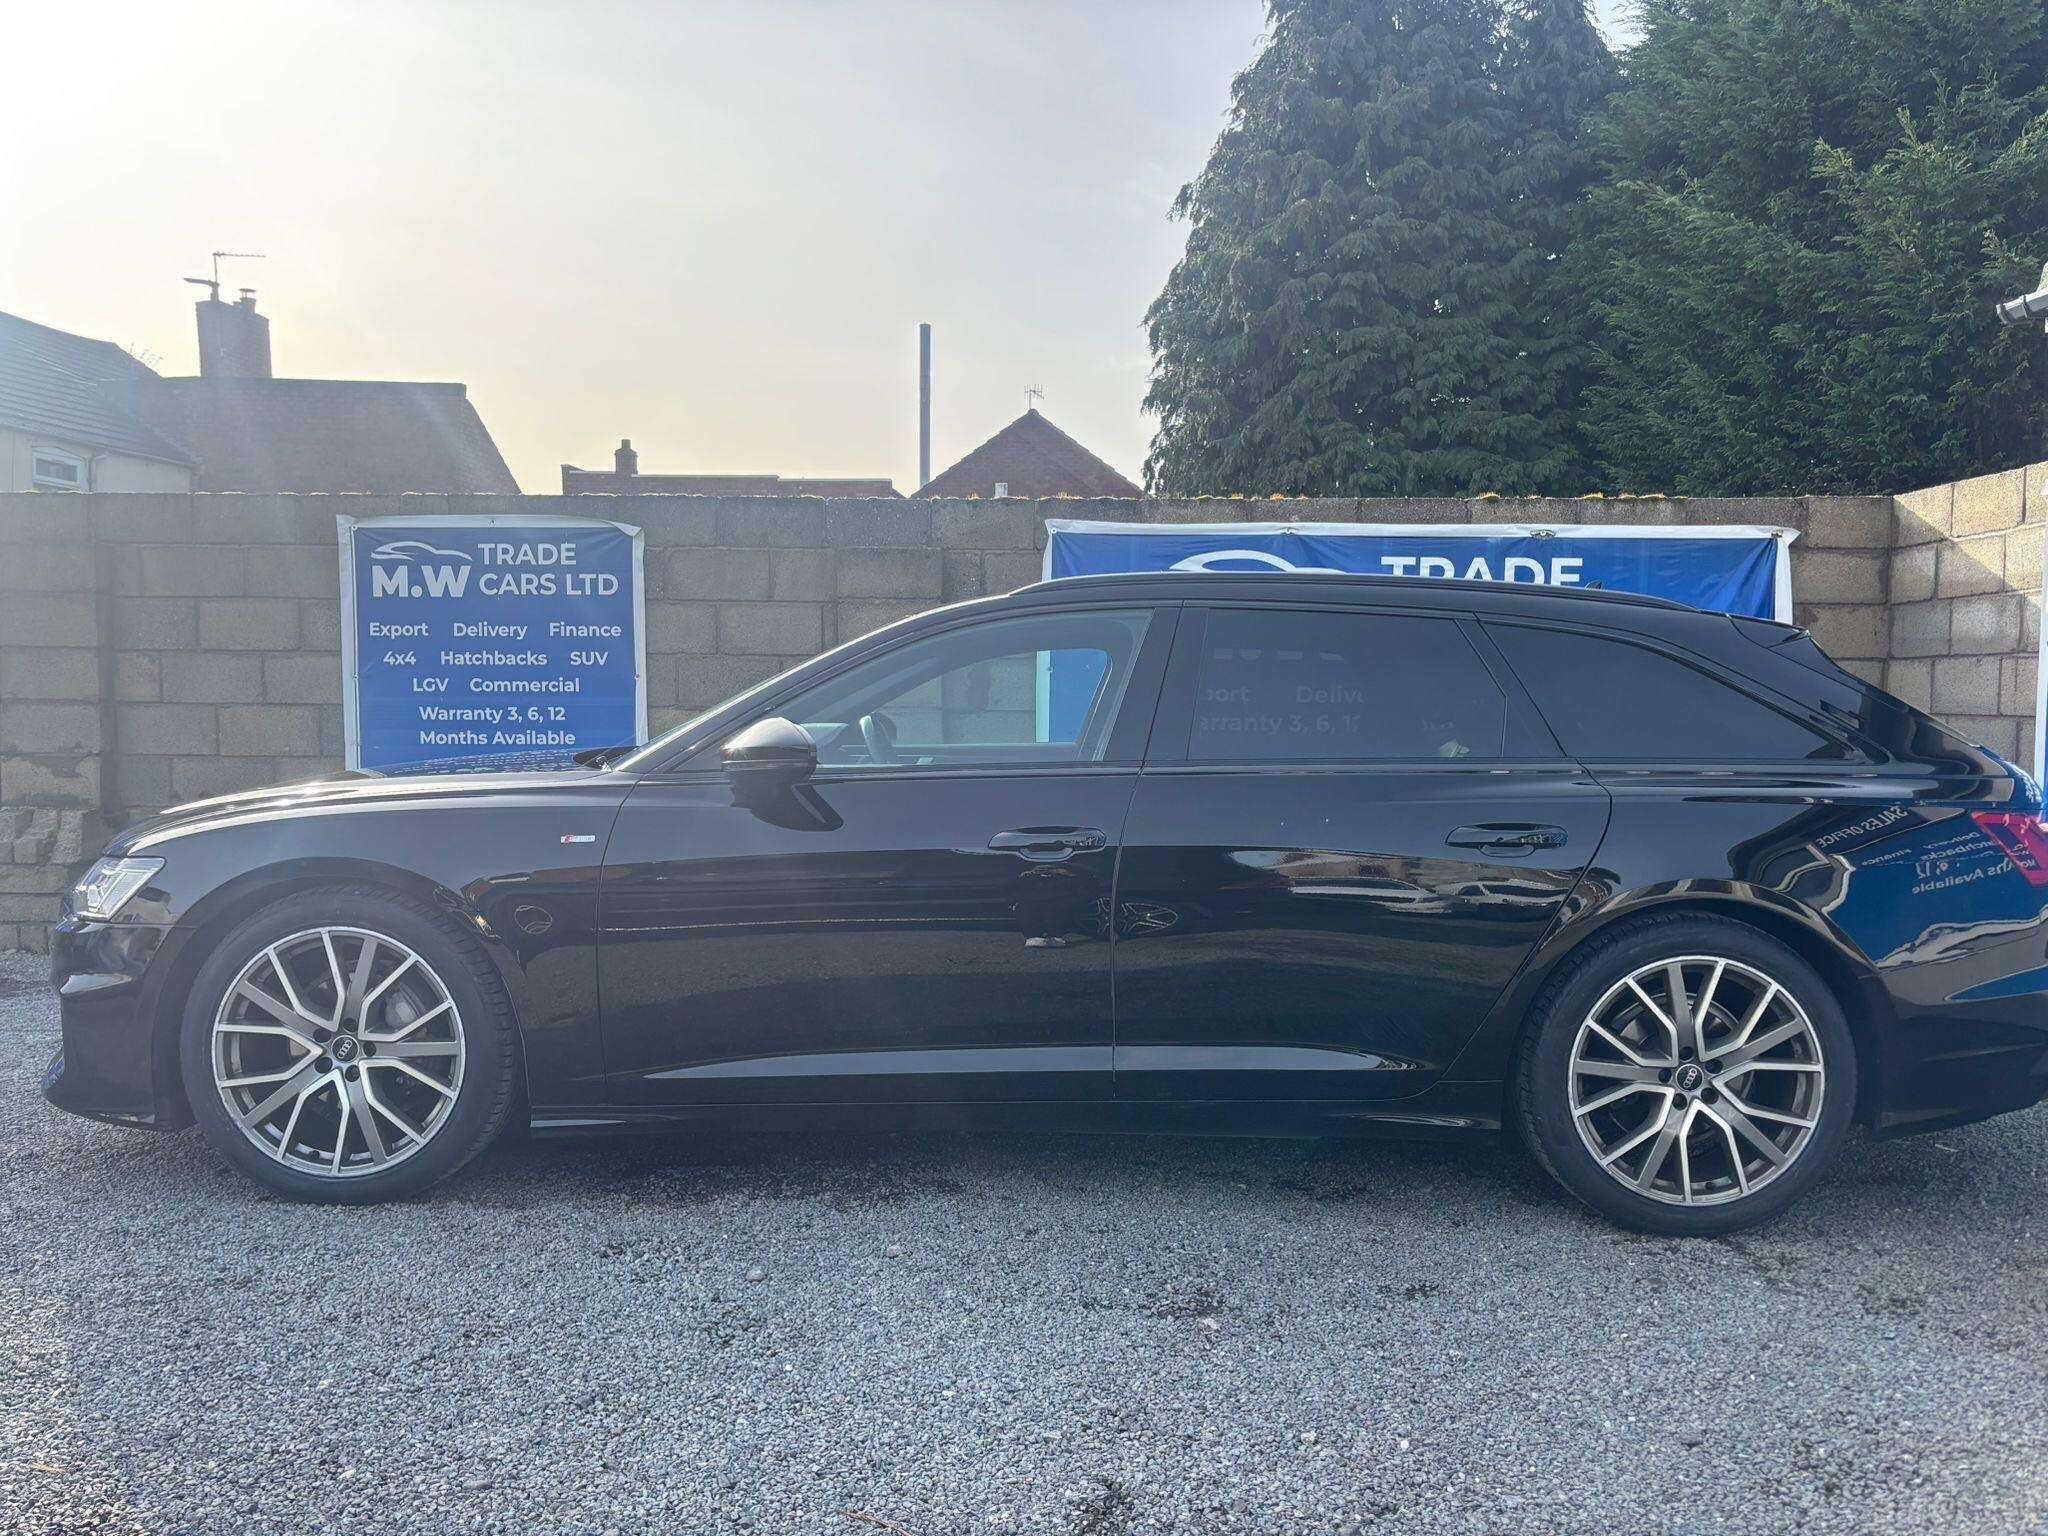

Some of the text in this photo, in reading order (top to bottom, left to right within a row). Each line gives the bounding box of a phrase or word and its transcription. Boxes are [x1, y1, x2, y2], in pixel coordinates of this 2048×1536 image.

[478, 543, 577, 565] TRADE
[371, 565, 471, 598] M.W
[479, 573, 619, 595] CARS LTD
[369, 621, 622, 640] Export Delivery Finance
[383, 650, 608, 666] 4x4 Hatchbacks SUV
[413, 677, 581, 692] LGV Commercial
[418, 706, 566, 724] Warranty 3, 6, 12
[1199, 713, 1284, 735] arranty
[420, 730, 576, 745] Months Available
